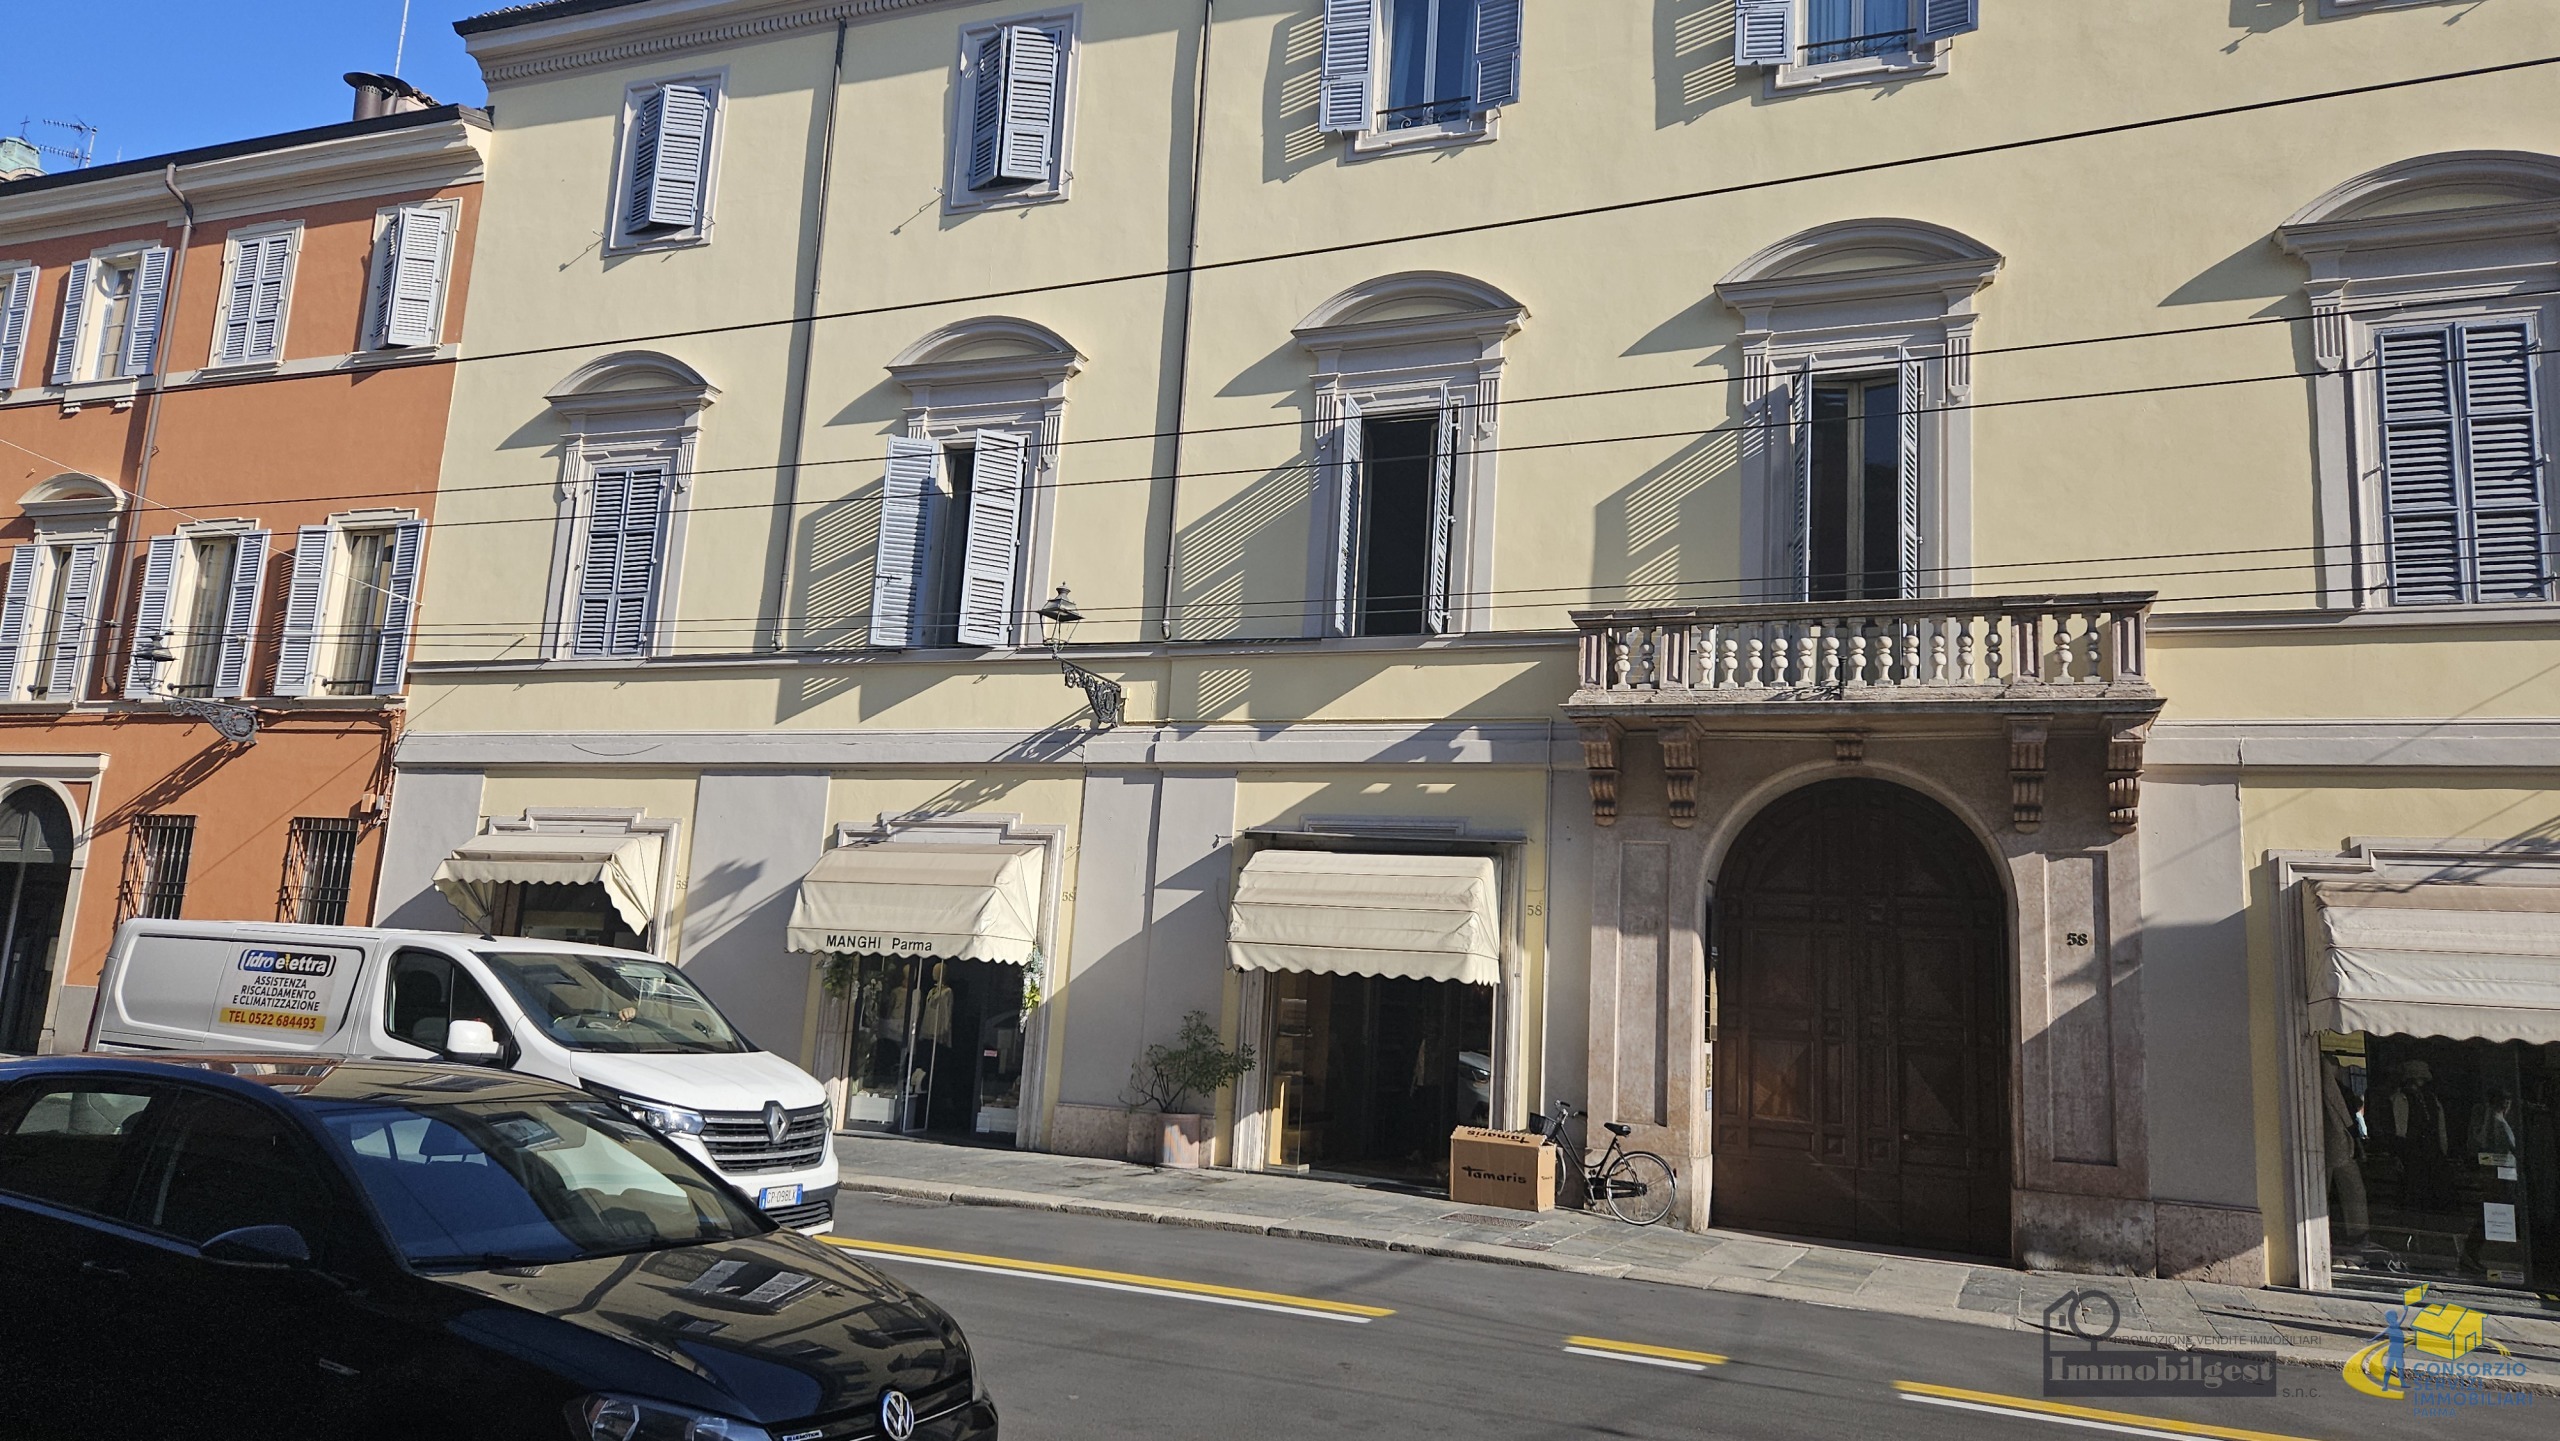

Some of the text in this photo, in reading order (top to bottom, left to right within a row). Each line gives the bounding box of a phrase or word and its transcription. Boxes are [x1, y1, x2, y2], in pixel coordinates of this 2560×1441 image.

[826, 935, 932, 951] MANGHI Parma
[2066, 932, 2088, 946] 58
[254, 976, 307, 989] ASSISTENZA
[241, 985, 316, 1000] RISCALDAMENTO
[232, 995, 320, 1011] E CLIMATIZZAZIONE
[229, 1010, 317, 1029] TEL 0522 684493
